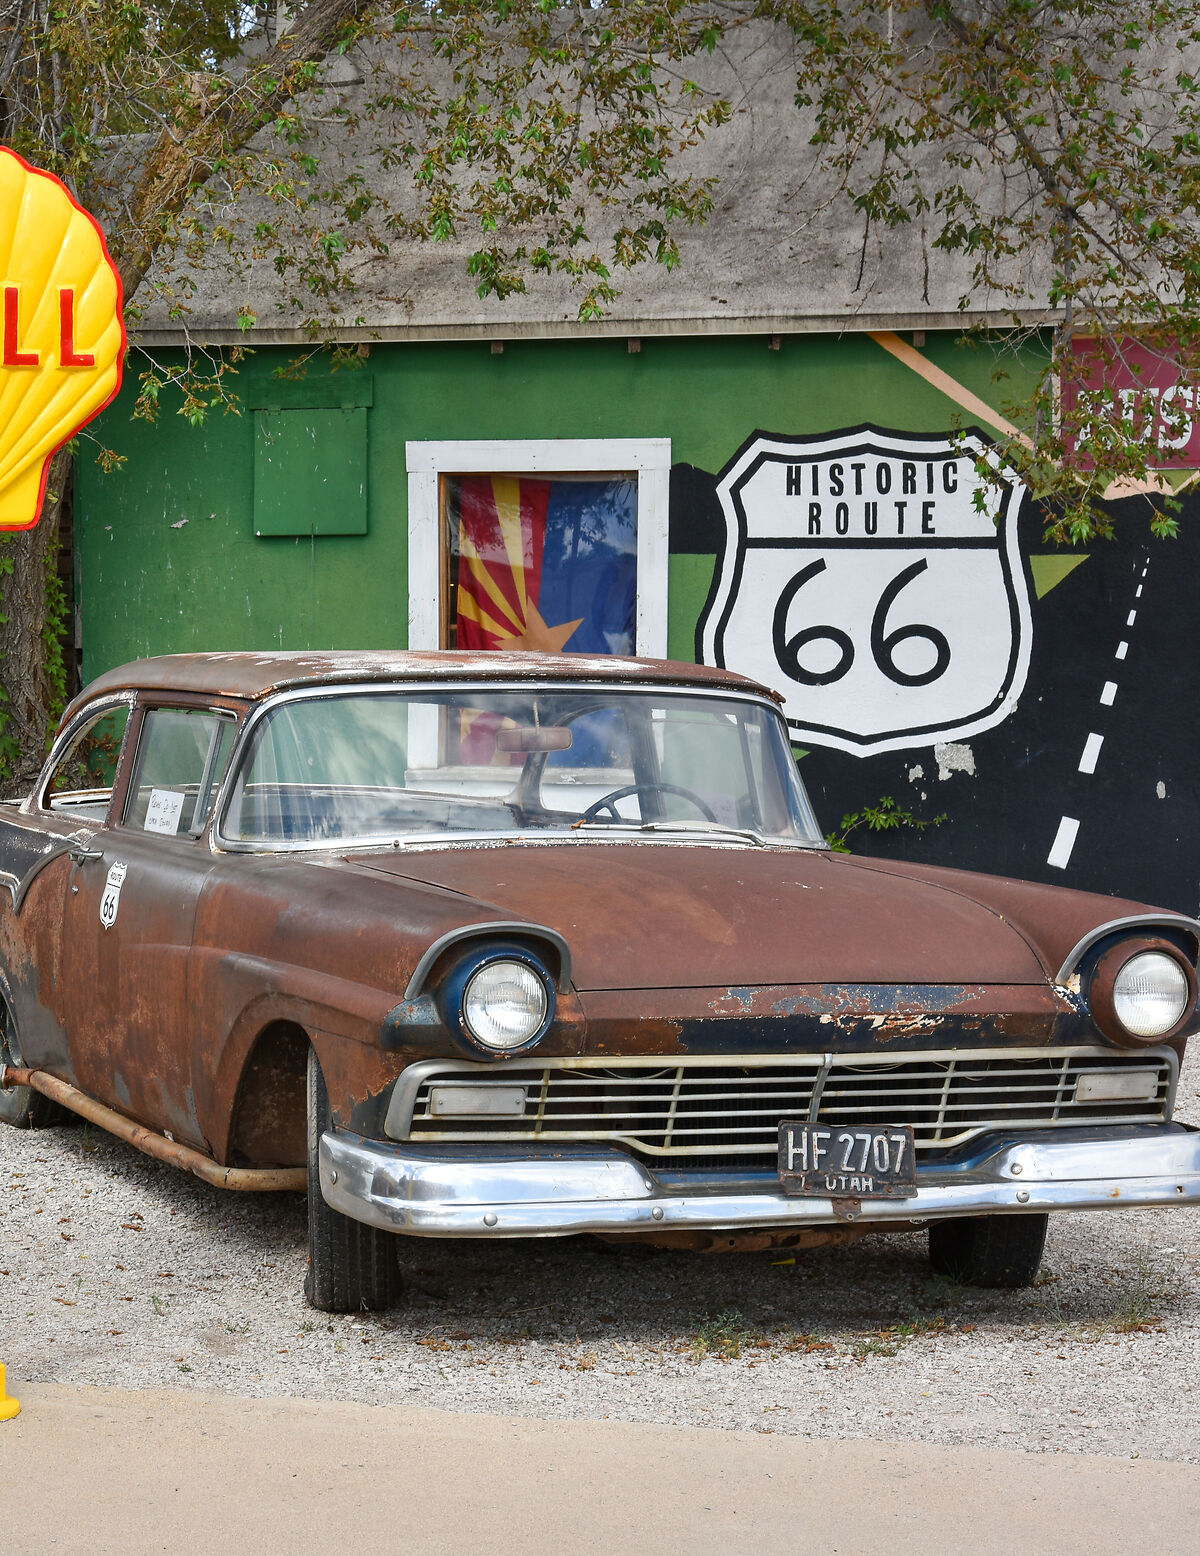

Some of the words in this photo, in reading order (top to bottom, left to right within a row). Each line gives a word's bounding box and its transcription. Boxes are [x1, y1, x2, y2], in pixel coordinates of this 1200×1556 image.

[785, 460, 960, 497] HISTORIC
[807, 500, 937, 536] ROUTE
[772, 557, 951, 687] 66
[103, 894, 115, 919] 66
[787, 1130, 831, 1171] HF
[838, 1133, 906, 1174] 2707
[825, 1176, 874, 1192] UTAH
